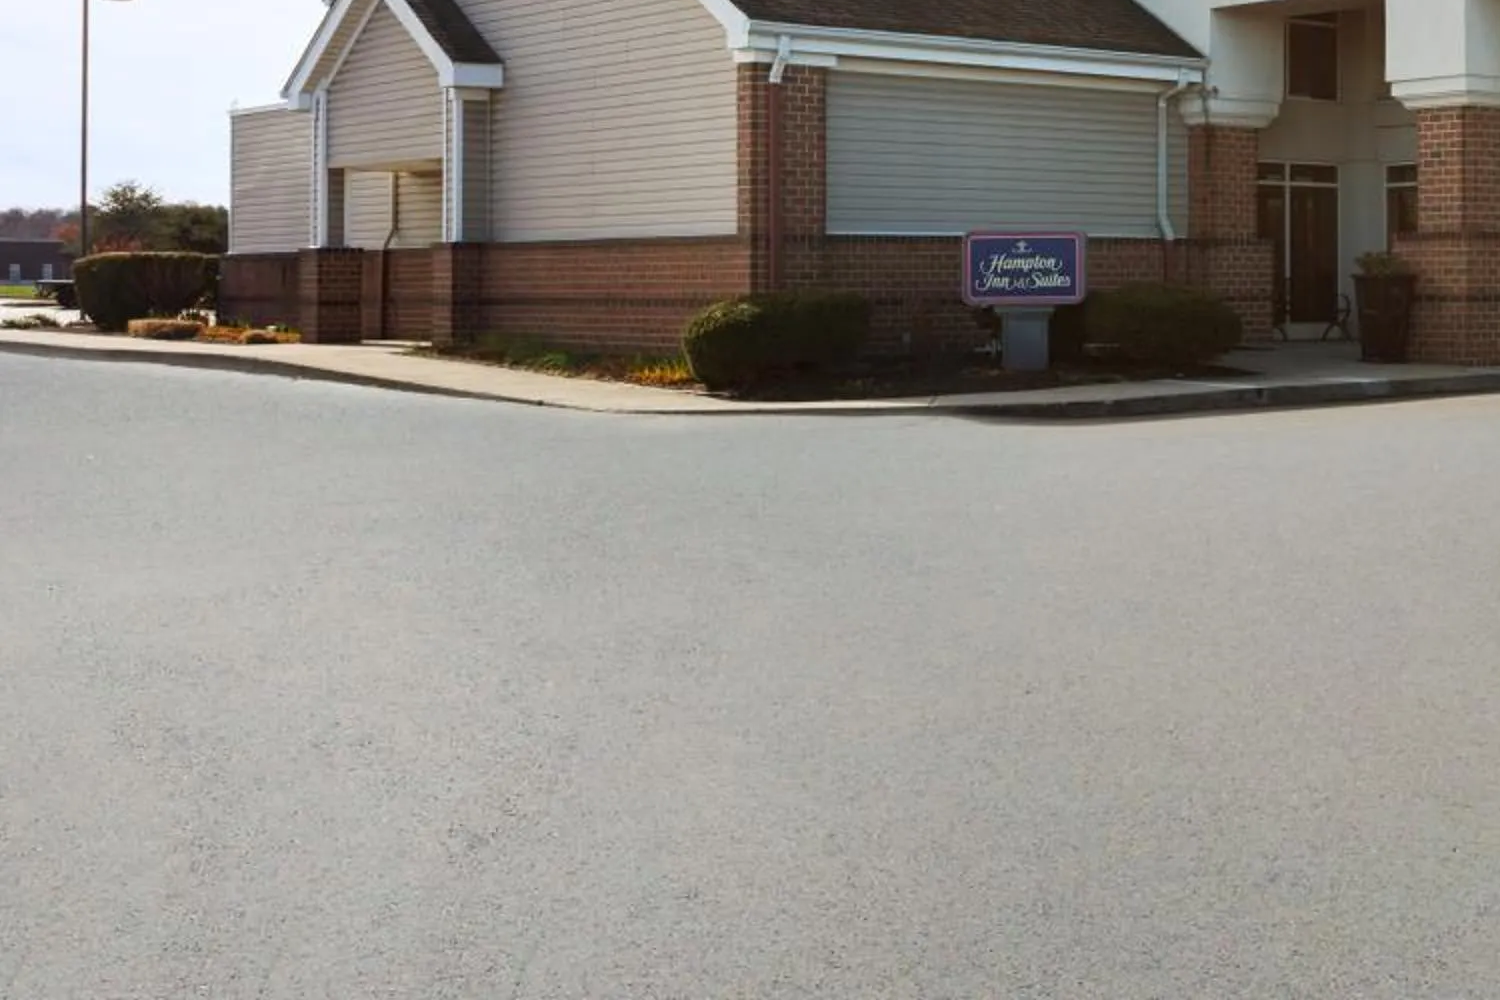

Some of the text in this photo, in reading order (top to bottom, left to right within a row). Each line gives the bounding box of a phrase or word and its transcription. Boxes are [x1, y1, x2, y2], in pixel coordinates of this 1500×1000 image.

[979, 252, 1063, 274] Hampton
[976, 273, 1014, 291] Inn
[1027, 271, 1071, 289] Suites
